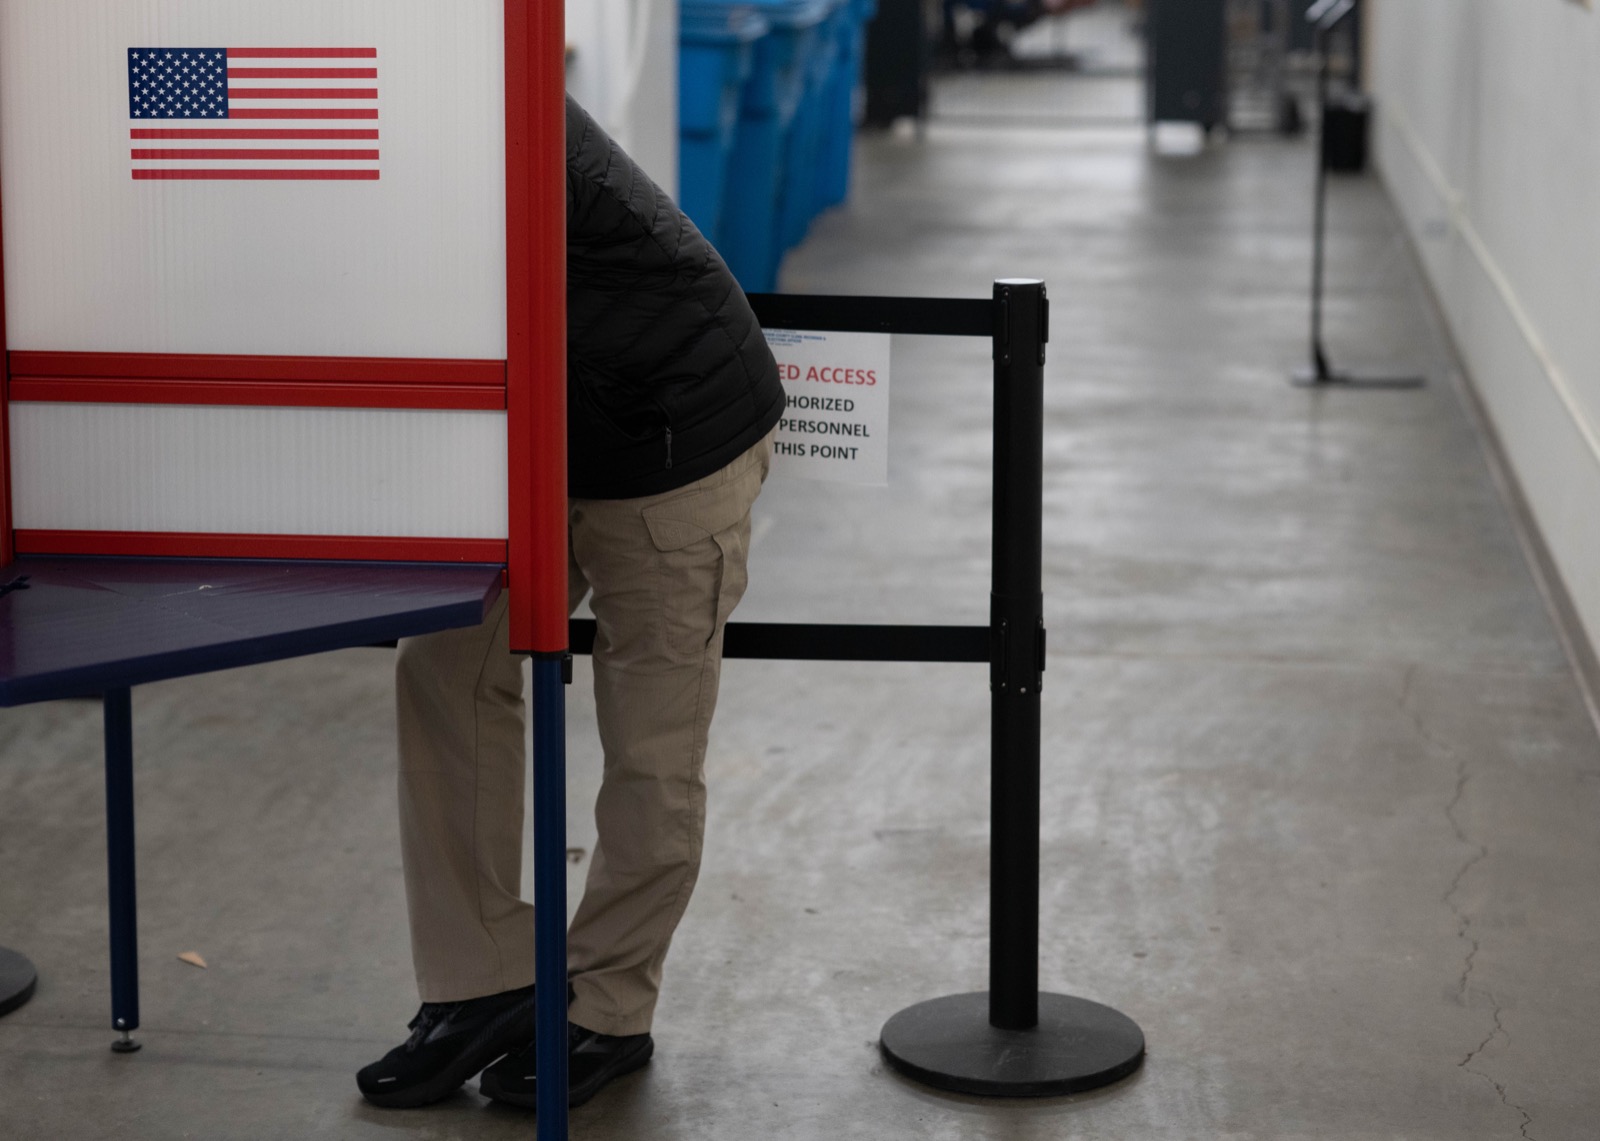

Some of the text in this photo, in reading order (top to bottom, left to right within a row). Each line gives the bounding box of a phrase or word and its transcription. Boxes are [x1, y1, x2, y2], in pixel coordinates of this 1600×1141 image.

[806, 366, 876, 386] ACCESS
[786, 395, 855, 412] HORIZED
[779, 418, 870, 437] PERSONNEL
[774, 441, 859, 460] THIS POINT
